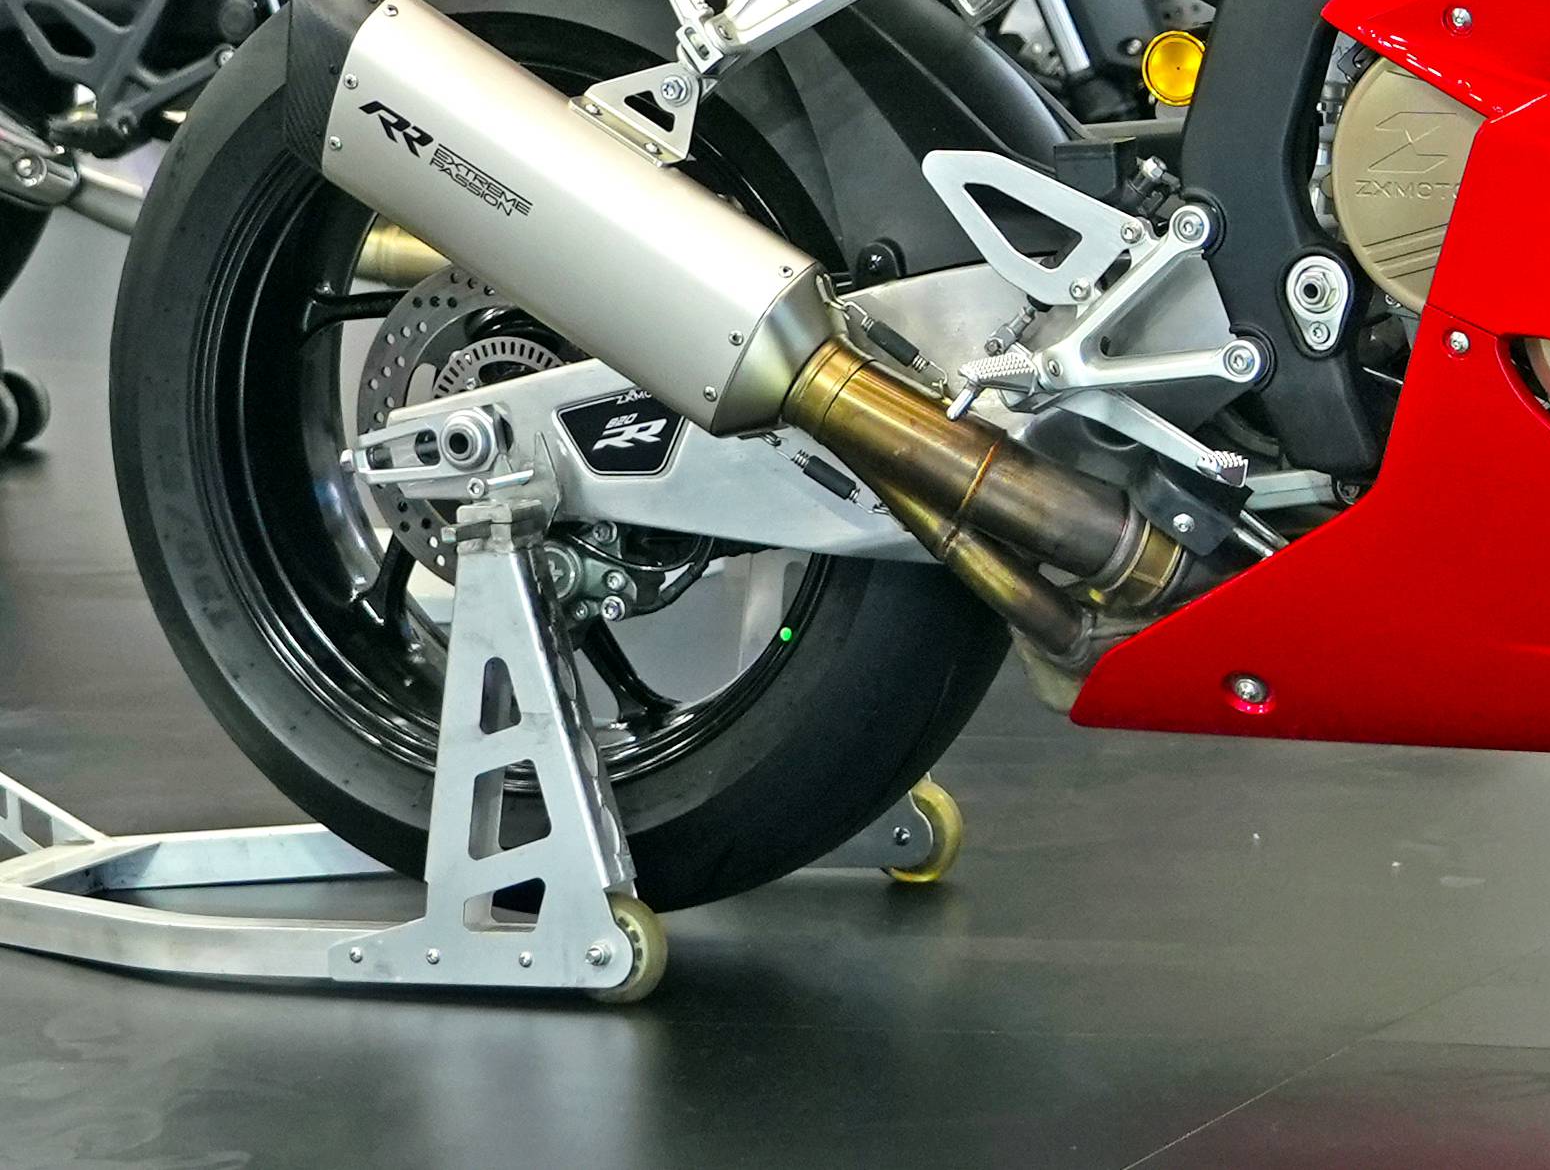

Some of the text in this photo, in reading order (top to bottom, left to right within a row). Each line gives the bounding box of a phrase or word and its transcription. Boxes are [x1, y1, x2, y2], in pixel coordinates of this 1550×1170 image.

[358, 100, 434, 158] RR
[429, 157, 513, 217] PASSION
[433, 147, 532, 217] EXTREME
